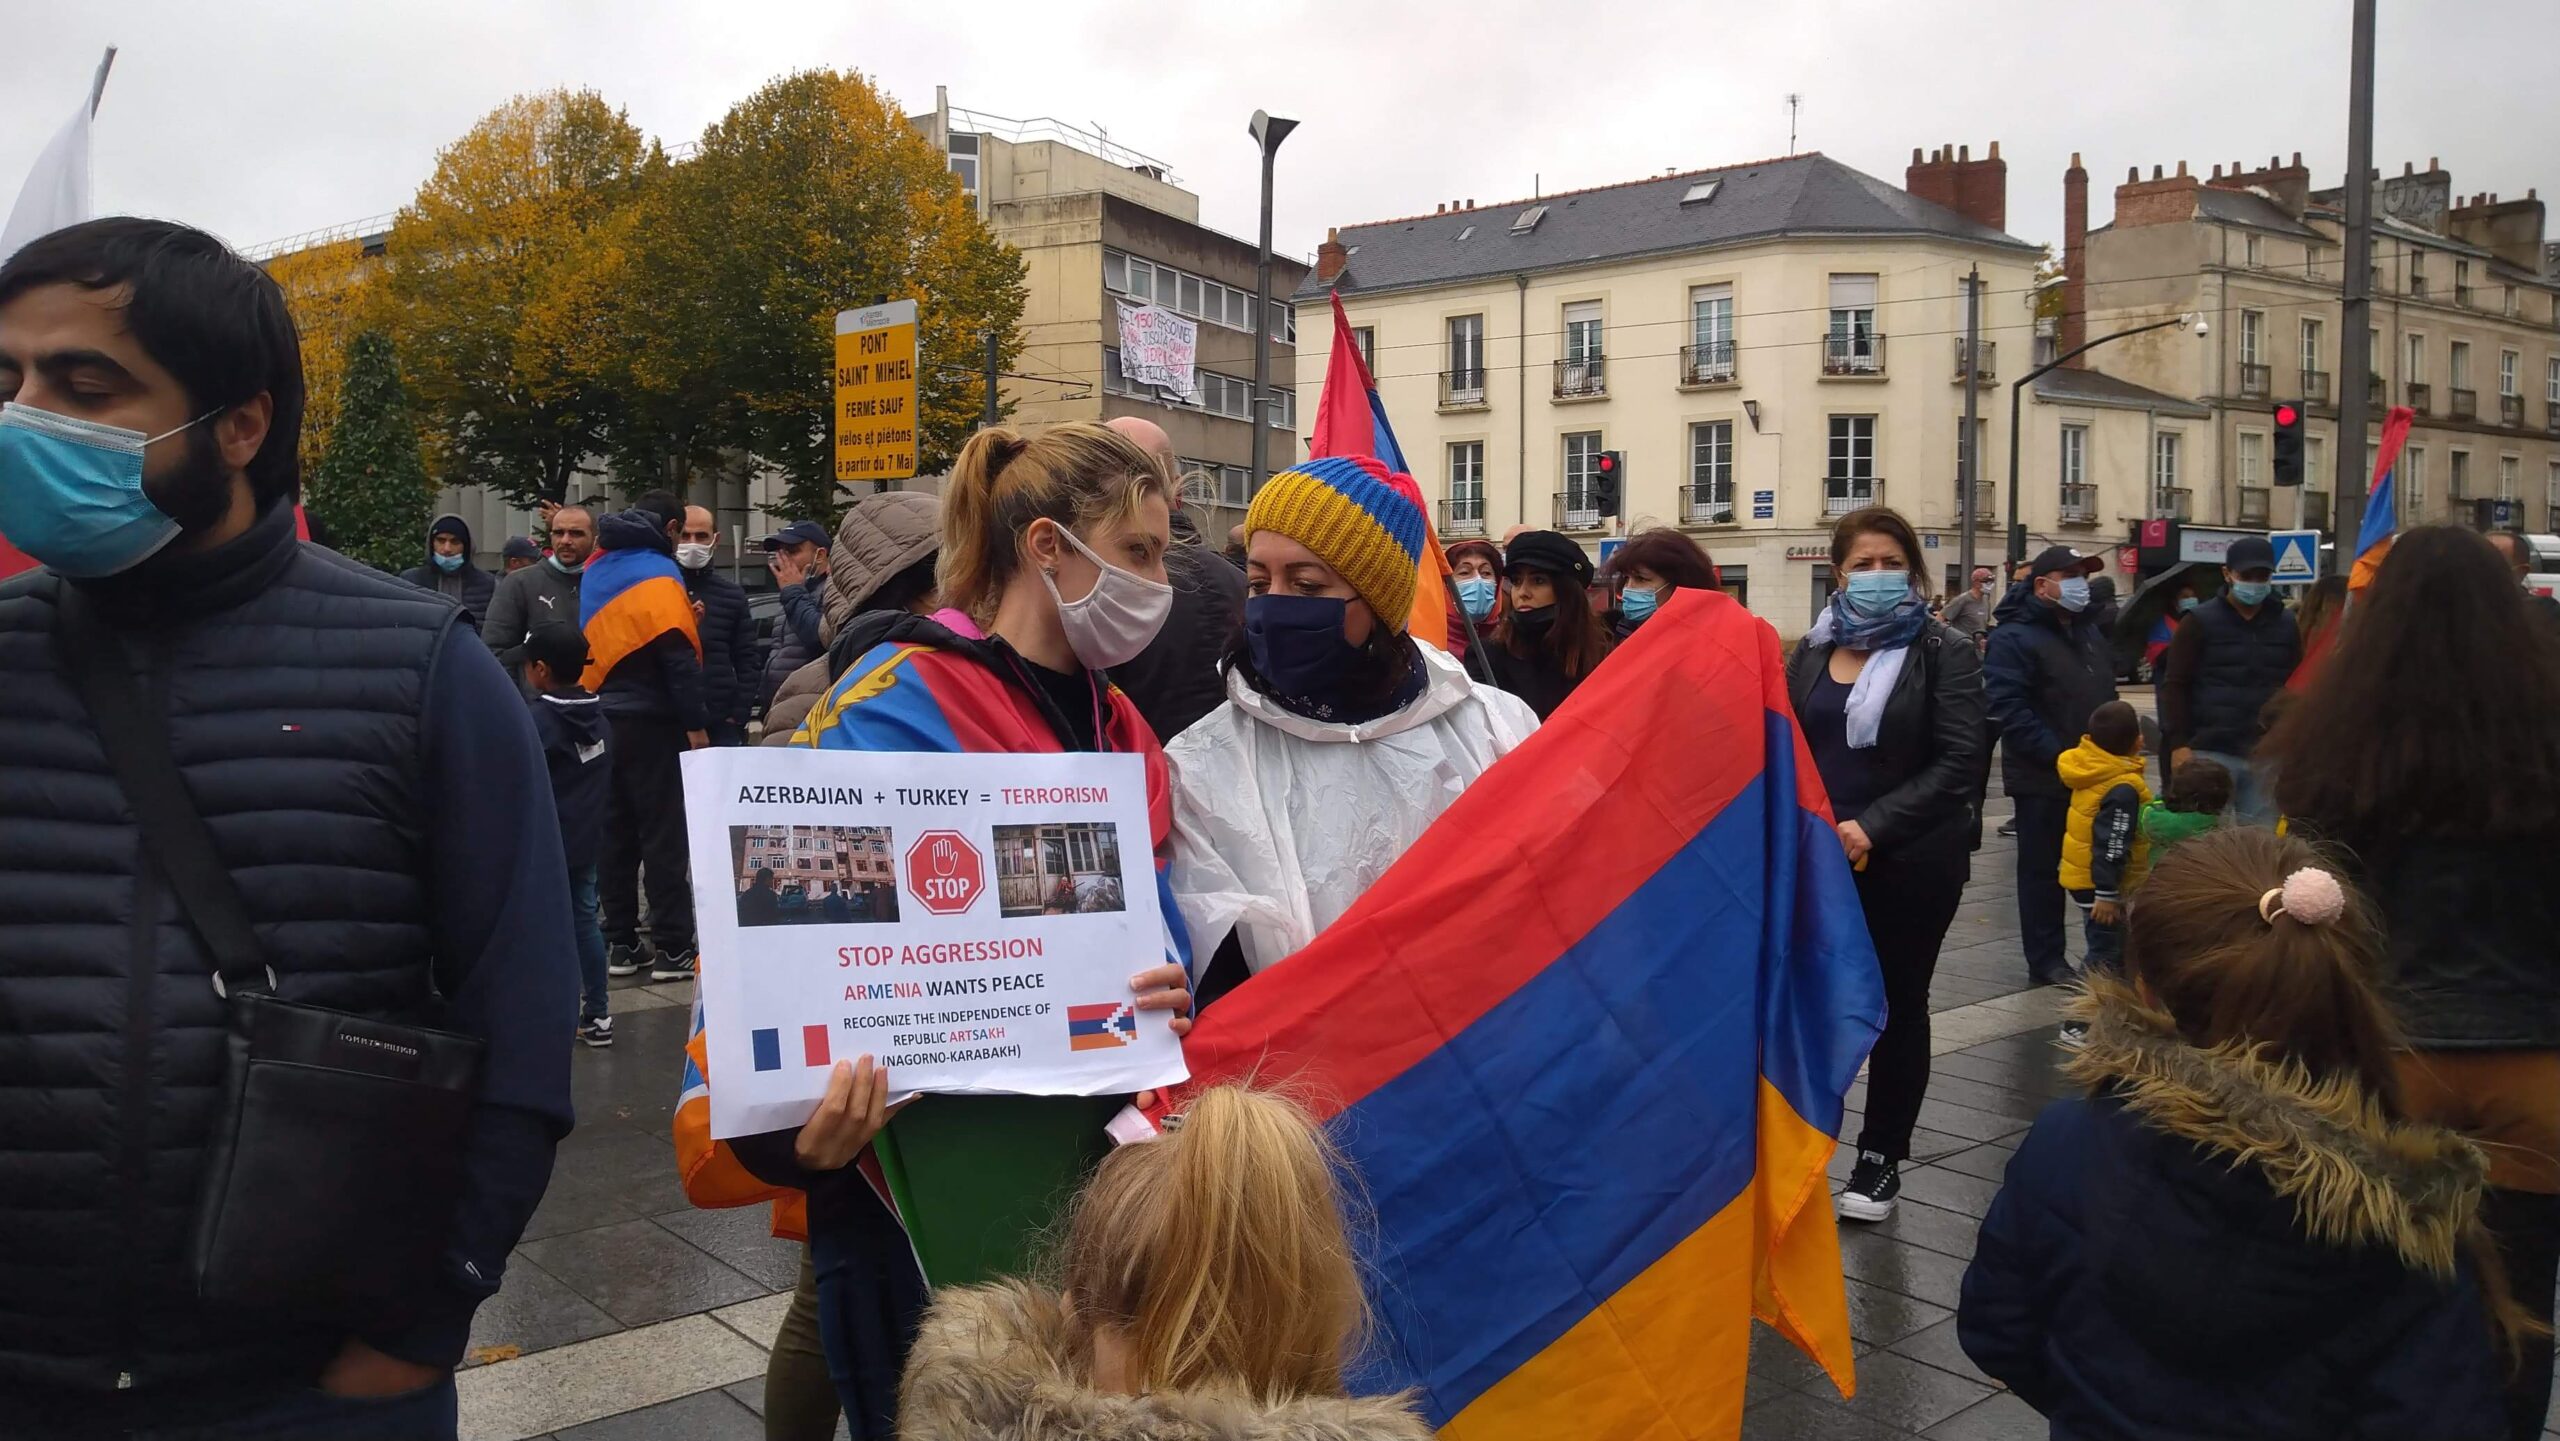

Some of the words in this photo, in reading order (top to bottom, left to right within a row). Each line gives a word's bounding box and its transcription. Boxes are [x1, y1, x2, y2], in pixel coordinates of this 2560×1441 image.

[1135, 313, 1153, 328] 150
[861, 332, 888, 355] PONT
[839, 365, 868, 387] SAINT
[876, 360, 911, 383] MIHIEL
[846, 396, 876, 418] FERMÉ
[879, 396, 904, 415] SAUF
[839, 429, 862, 446] vélos
[865, 429, 874, 445] et
[877, 427, 912, 448] piétons
[838, 457, 842, 472] à
[846, 456, 870, 476] partir
[874, 456, 884, 471] du
[888, 454, 893, 470] 7
[897, 453, 913, 470] Mai
[738, 785, 863, 805] AZERBAJIAN
[874, 791, 886, 804] +
[896, 788, 969, 806] TURKEY
[1001, 787, 1109, 805] TERRORISM
[925, 877, 970, 900] STOP
[838, 946, 894, 967] STOP
[901, 937, 1043, 965] AGGRESSION
[844, 982, 922, 1001] ARMENIA
[926, 978, 987, 997] WANTS
[992, 973, 1045, 992] PEACE
[843, 1011, 911, 1029] RECOGNIZE
[913, 1010, 936, 1025] THE
[938, 1004, 1032, 1024] INDEPENDENCE
[1035, 1003, 1051, 1015] OF
[893, 1031, 947, 1046] REPUBLIC
[949, 1027, 1005, 1043] ARTSAKH
[882, 1044, 1021, 1067] (NAGORNO-KARABAKH)
